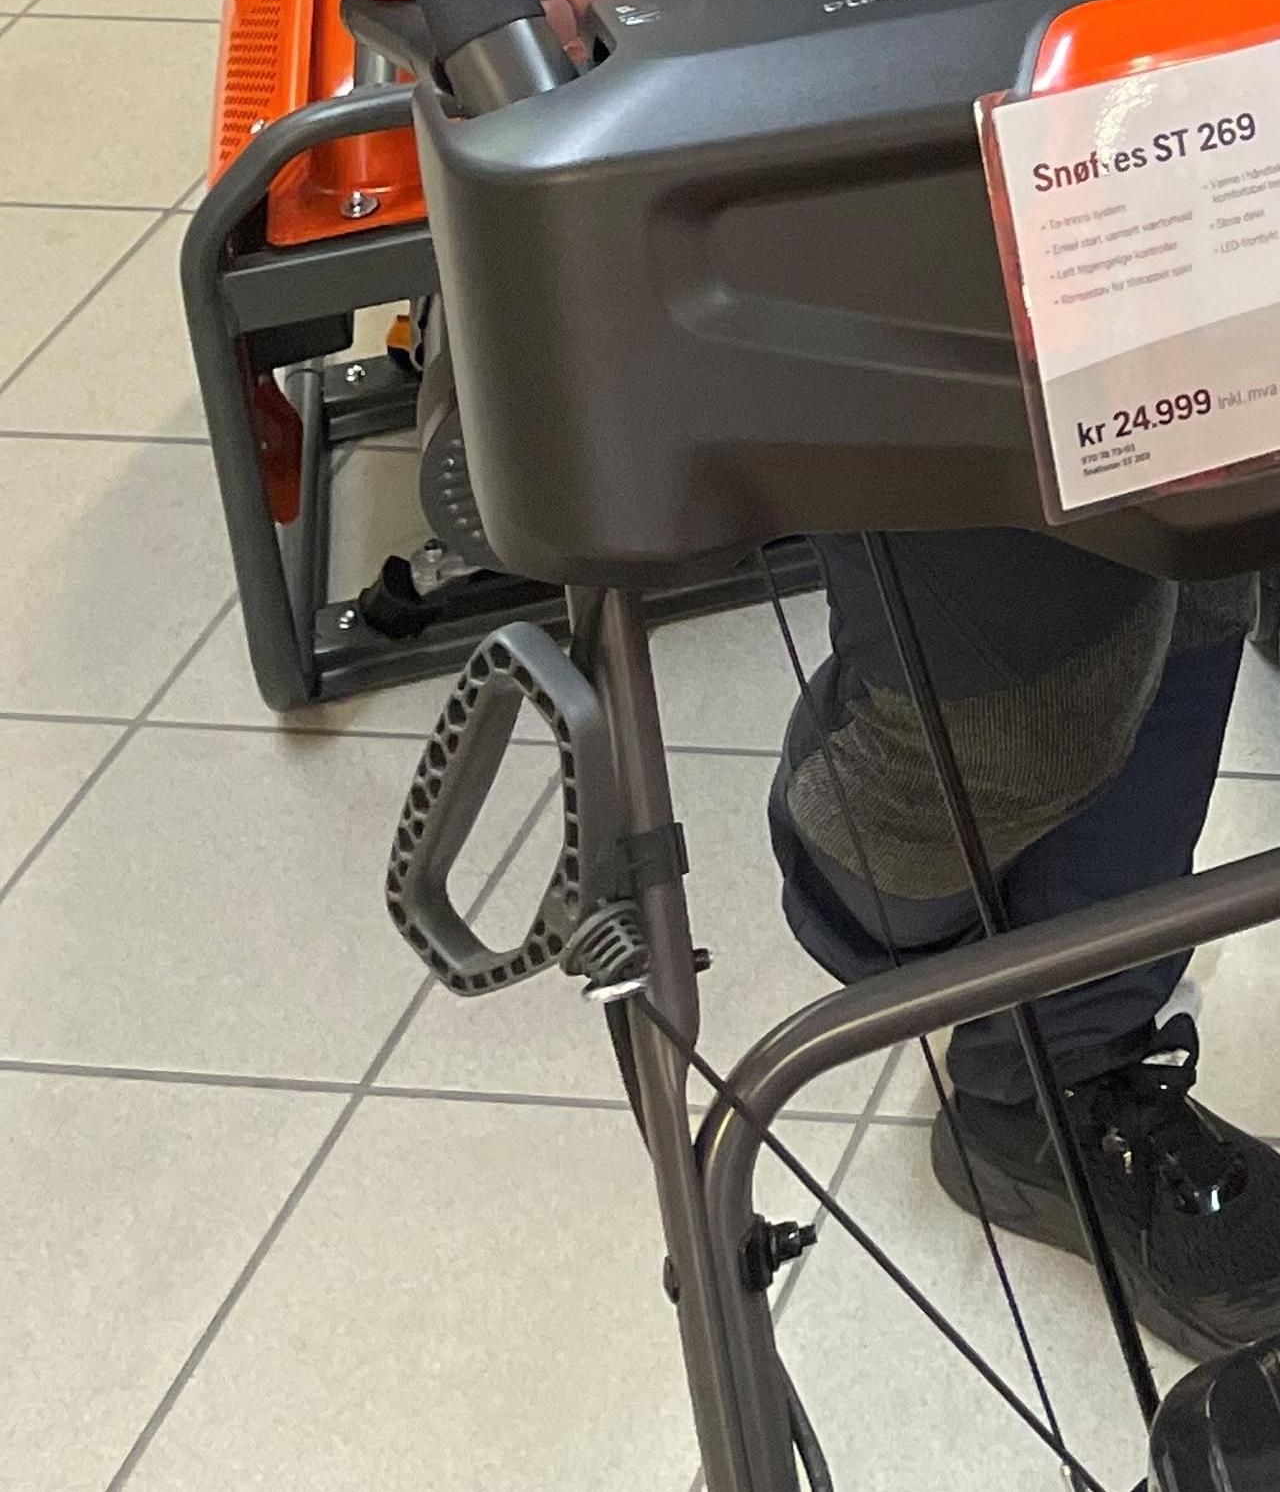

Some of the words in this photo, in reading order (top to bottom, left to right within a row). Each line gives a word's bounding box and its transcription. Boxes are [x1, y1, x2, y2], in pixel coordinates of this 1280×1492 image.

[1033, 145, 1148, 193] Snøfes
[1152, 128, 1190, 163] ST
[1196, 112, 1257, 153] 269
[1077, 421, 1106, 449] kr
[1112, 388, 1212, 439] 24.999
